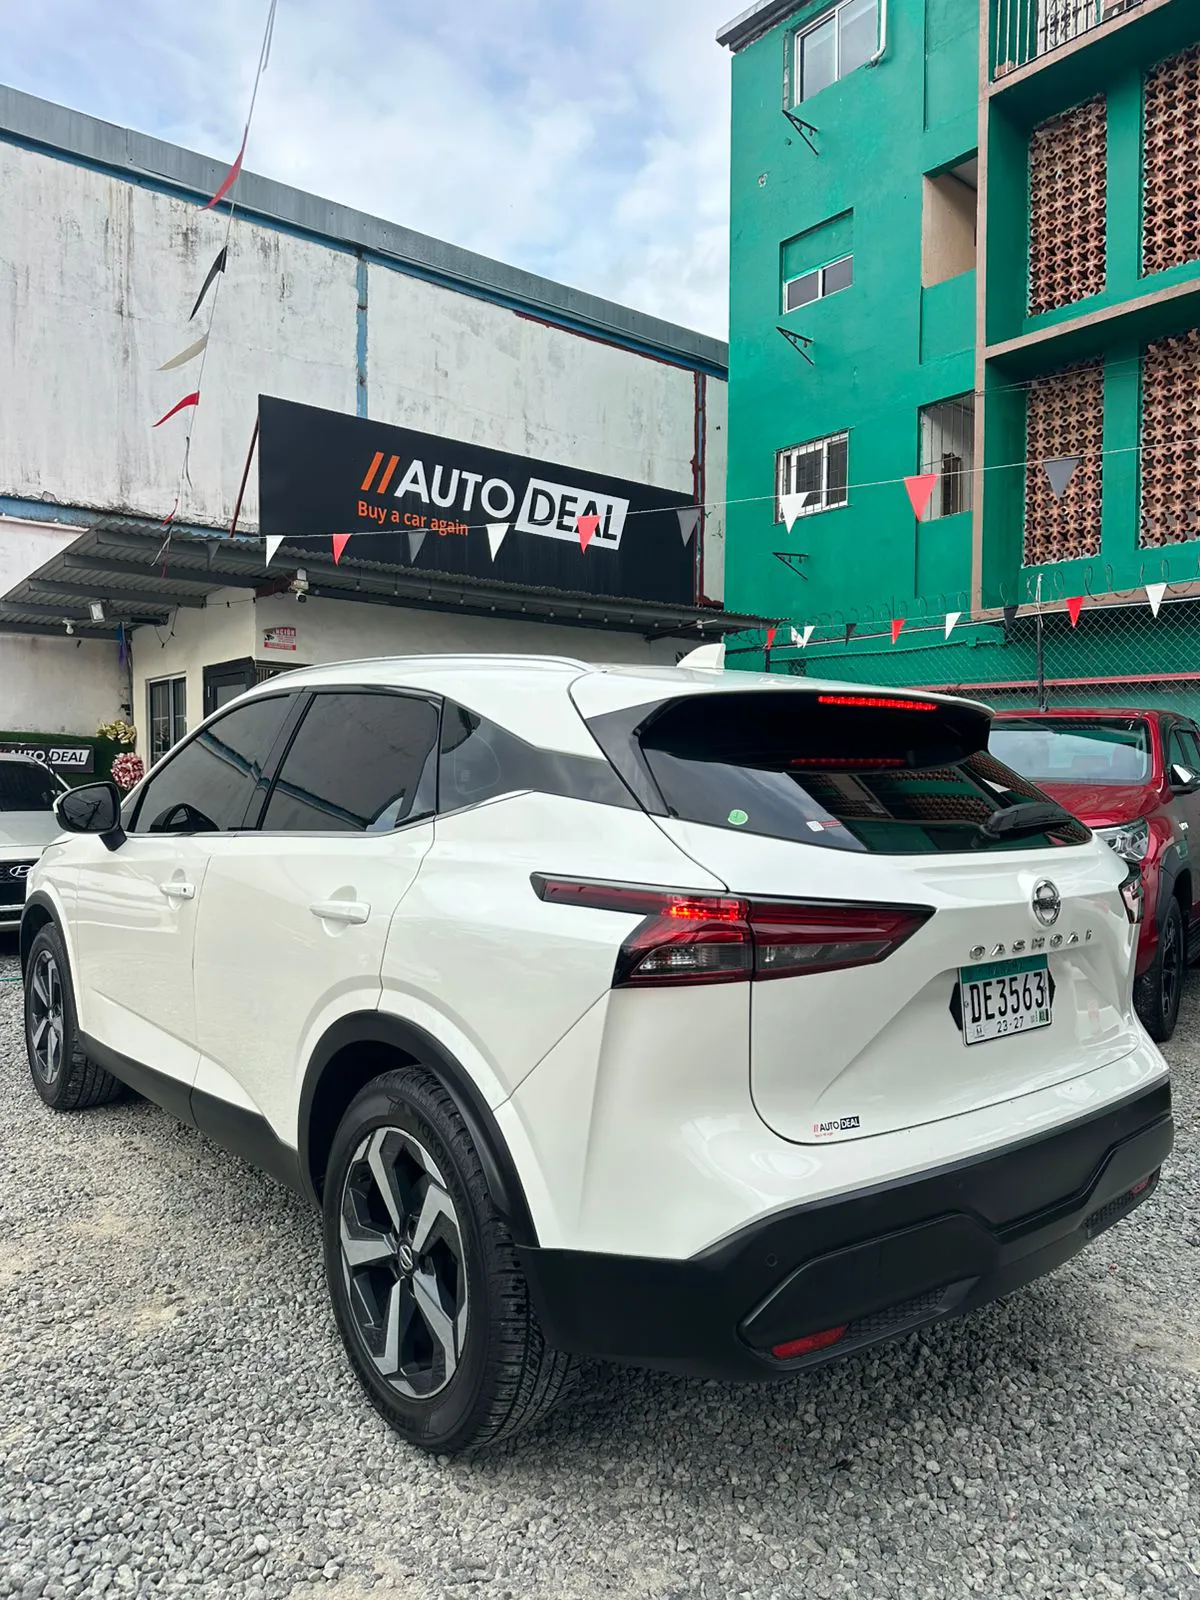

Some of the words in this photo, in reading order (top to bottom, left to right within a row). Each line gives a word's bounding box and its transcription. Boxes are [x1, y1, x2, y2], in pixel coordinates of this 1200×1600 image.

[357, 500, 387, 525] Buy
[391, 510, 400, 523] a
[403, 513, 427, 528] car
[430, 517, 469, 536] again
[50, 751, 86, 763] DEAL
[969, 972, 1044, 1023] DE3563
[841, 1116, 860, 1129] DEAL
